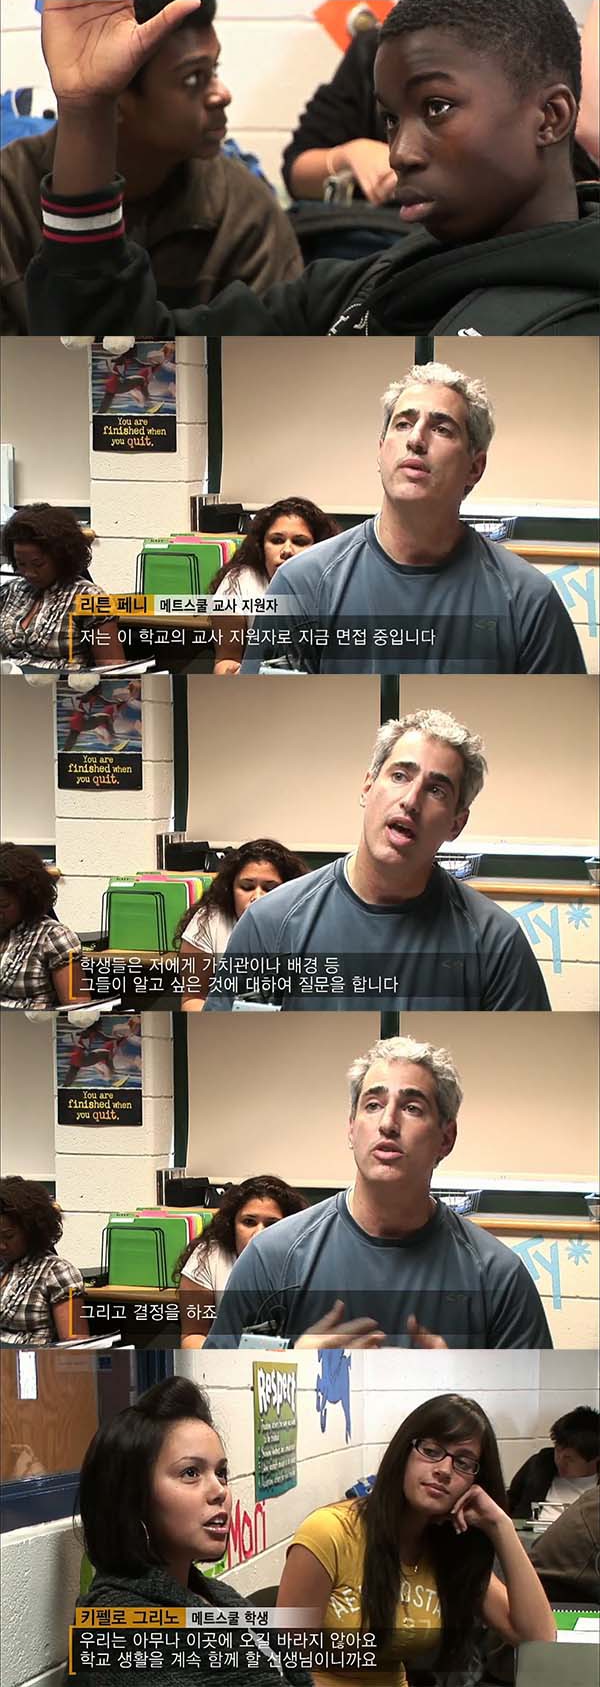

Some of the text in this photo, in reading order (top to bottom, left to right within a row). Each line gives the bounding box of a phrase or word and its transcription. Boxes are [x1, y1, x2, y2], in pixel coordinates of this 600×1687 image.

[118, 417, 132, 426] You
[103, 426, 145, 435] finished
[111, 435, 154, 447] you quit.
[83, 755, 97, 764] You
[68, 764, 110, 773] finished
[76, 773, 119, 785] you quit.
[83, 1091, 97, 1100] You
[68, 1100, 110, 1109] finished
[76, 1109, 119, 1121] you quit.
